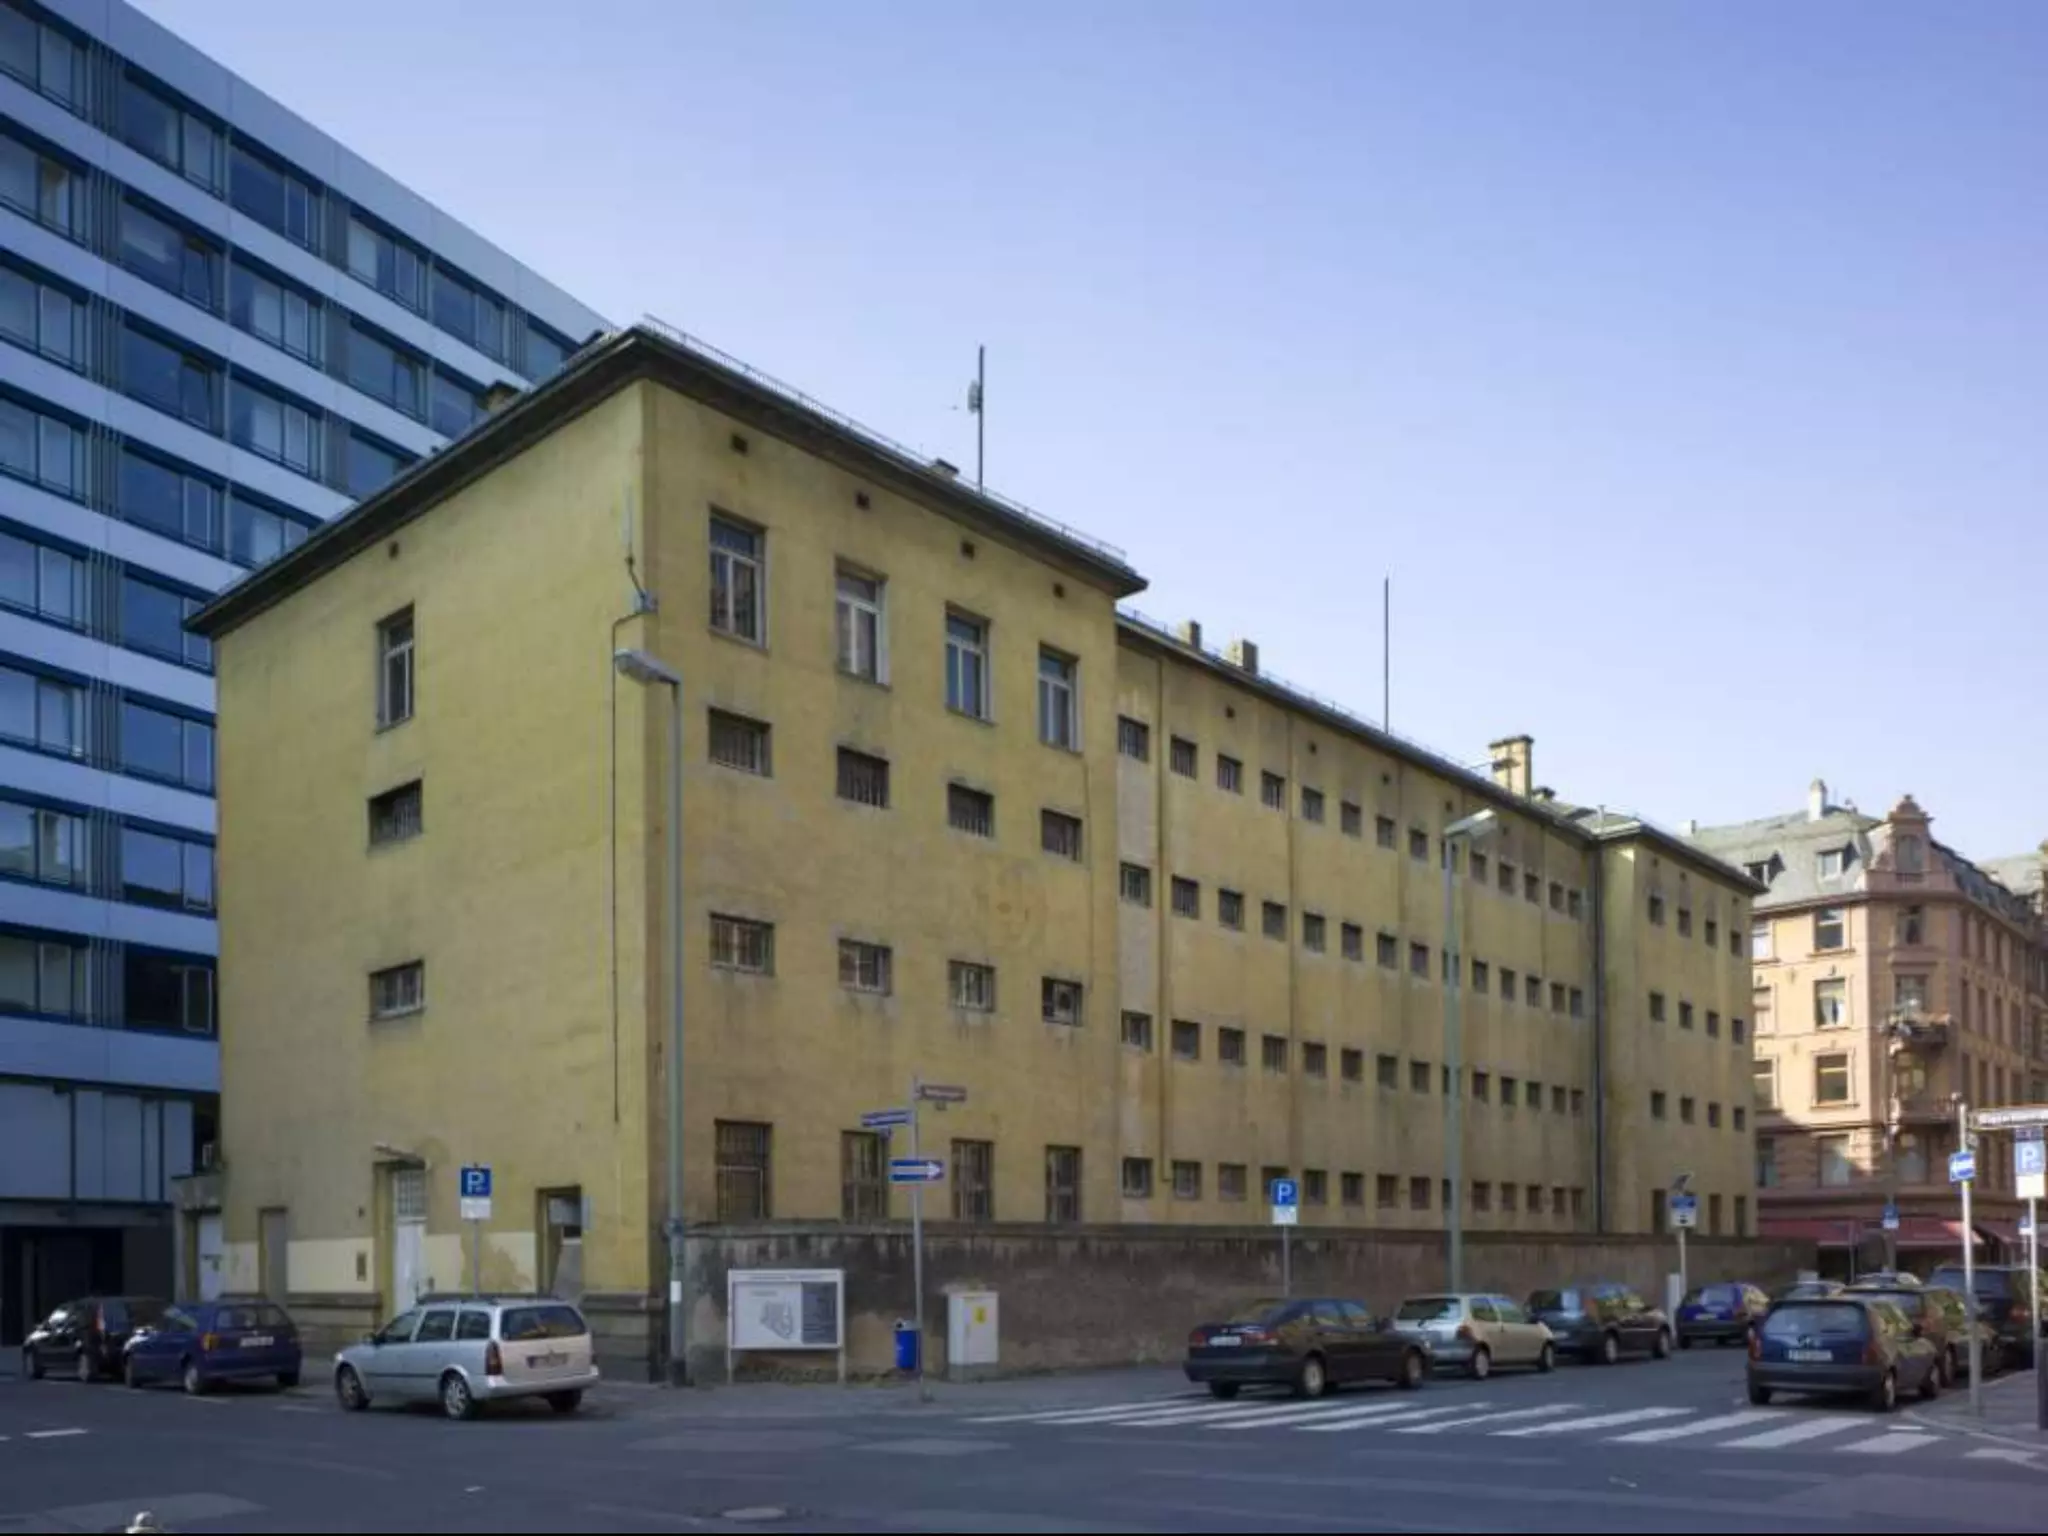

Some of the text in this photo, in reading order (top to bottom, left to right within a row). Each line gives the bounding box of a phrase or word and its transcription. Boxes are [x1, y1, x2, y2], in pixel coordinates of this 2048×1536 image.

[2021, 1146, 2039, 1169] P
[467, 1171, 486, 1194] P
[1277, 1182, 1293, 1204] P
